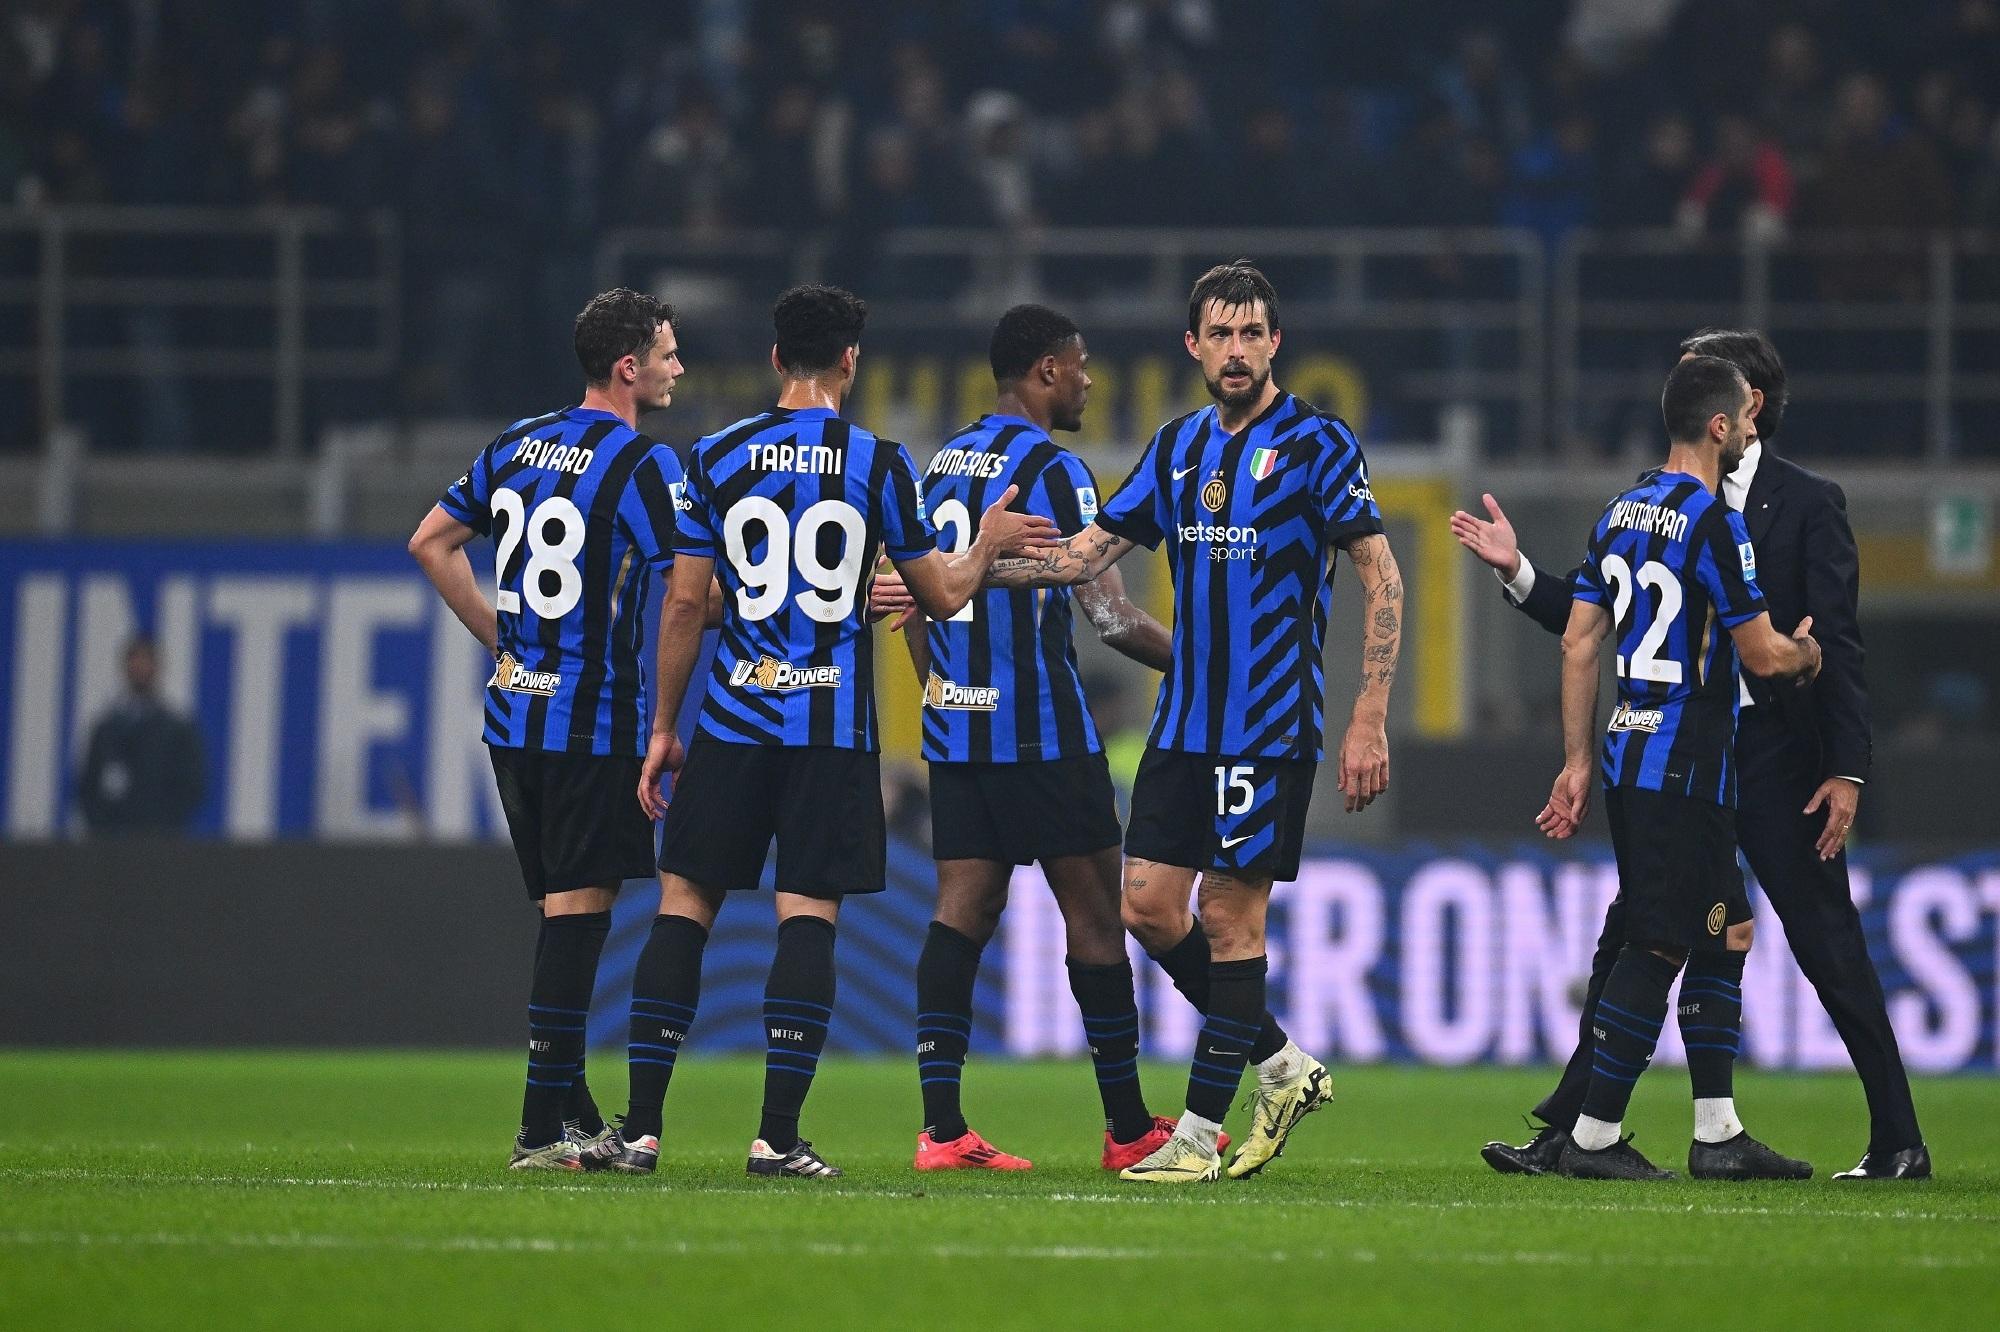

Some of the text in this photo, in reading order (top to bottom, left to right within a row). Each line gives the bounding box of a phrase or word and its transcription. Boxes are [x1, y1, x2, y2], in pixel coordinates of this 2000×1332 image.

[511, 436, 594, 475] PAVARD
[748, 444, 842, 475] TAREMI
[490, 487, 586, 620] 28
[723, 495, 867, 623] 99
[1600, 553, 1683, 684] 22
[1214, 766, 1255, 815] 15
[771, 1028, 804, 1041] INTER
